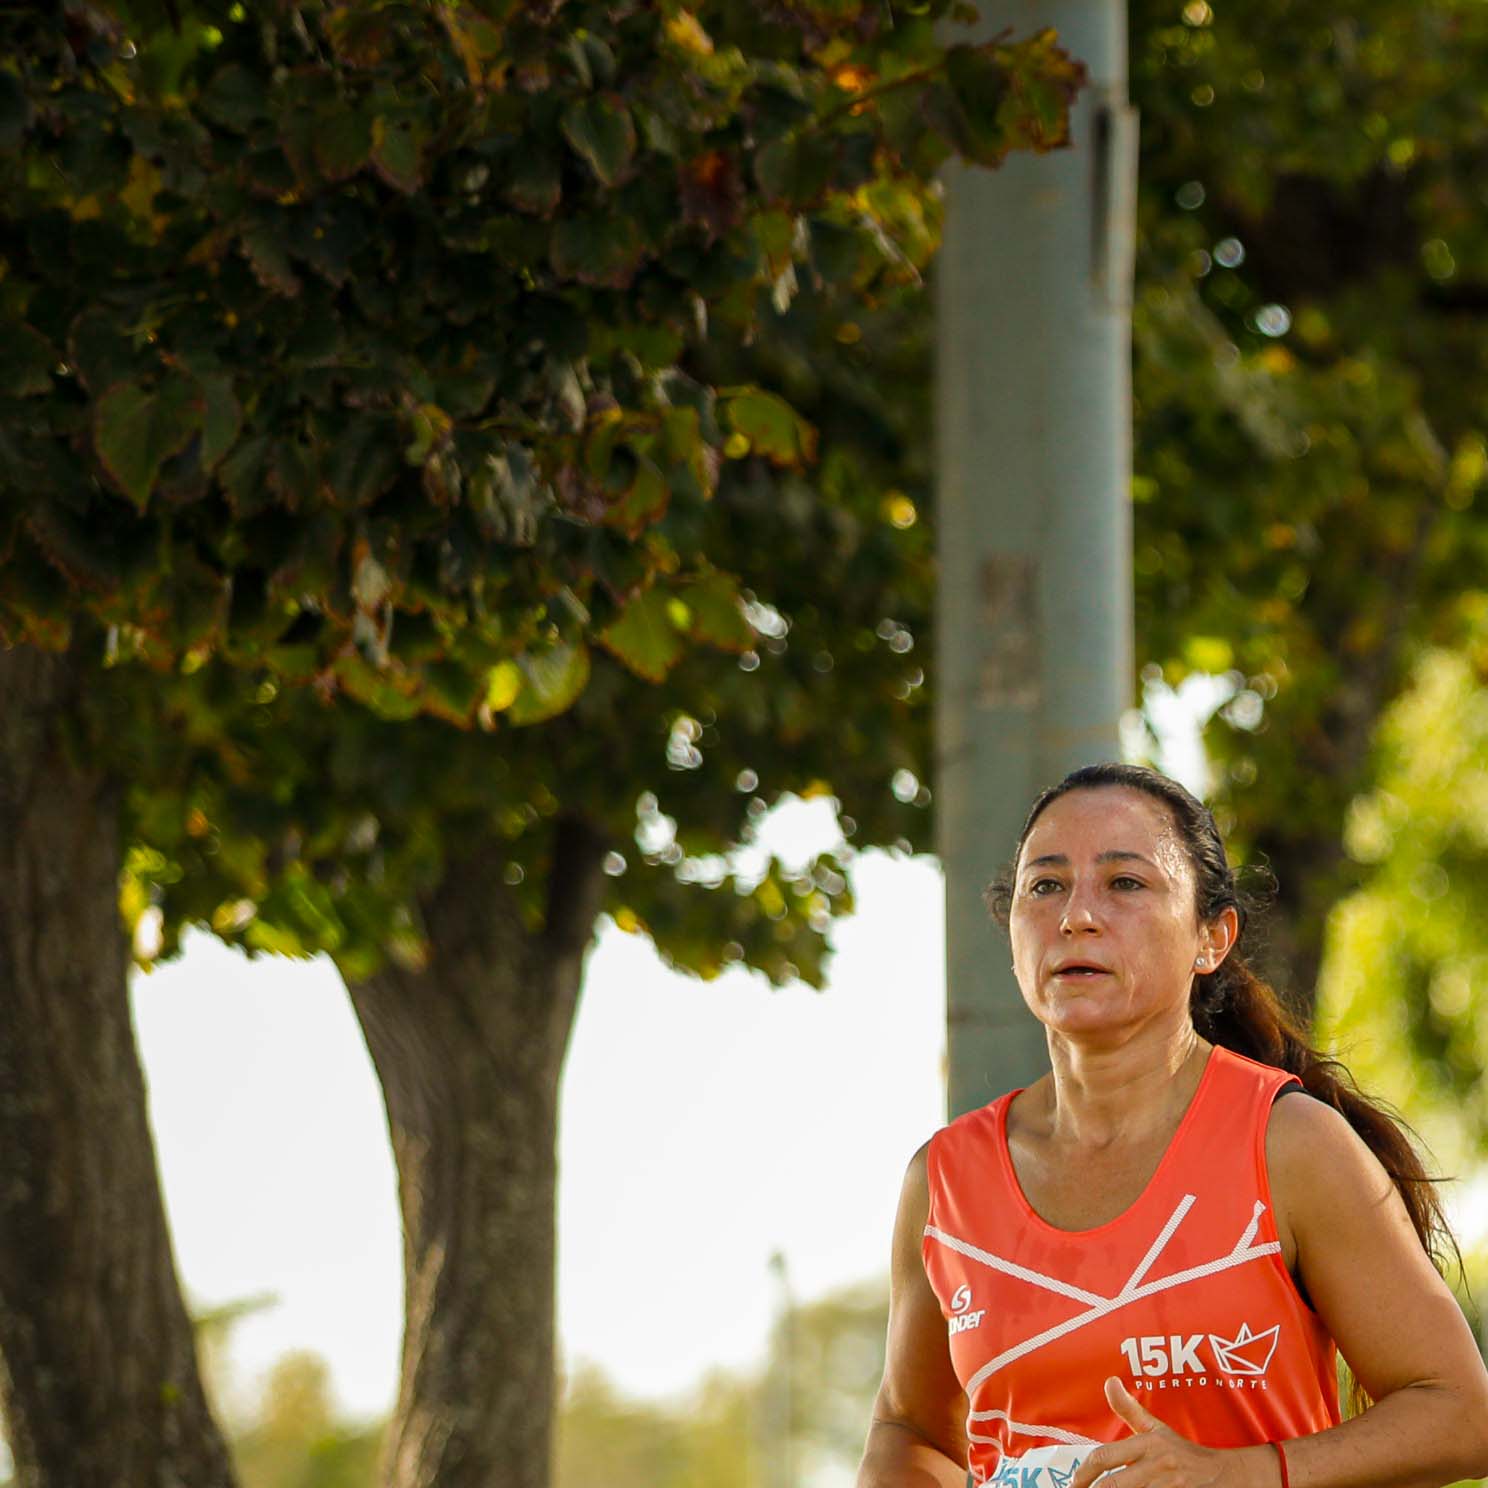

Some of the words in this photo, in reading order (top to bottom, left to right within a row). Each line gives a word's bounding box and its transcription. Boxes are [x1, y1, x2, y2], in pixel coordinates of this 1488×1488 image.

[1120, 1334, 1207, 1377] 15K
[1135, 1376, 1207, 1391] PUERTO
[1215, 1378, 1268, 1391] NORTE
